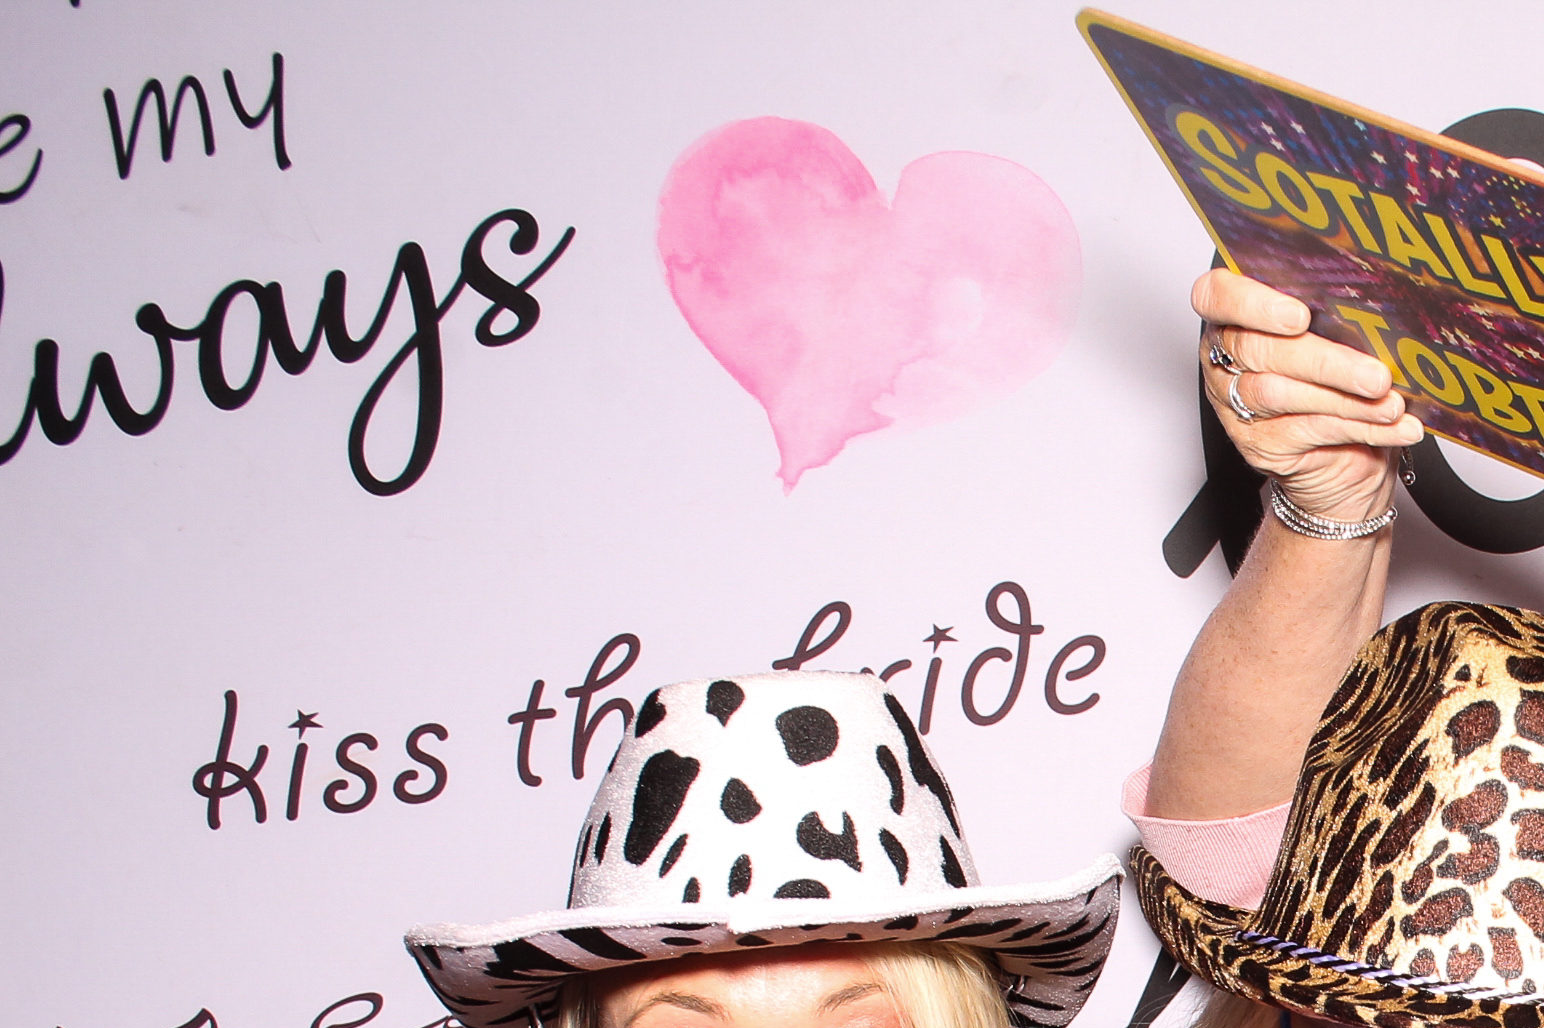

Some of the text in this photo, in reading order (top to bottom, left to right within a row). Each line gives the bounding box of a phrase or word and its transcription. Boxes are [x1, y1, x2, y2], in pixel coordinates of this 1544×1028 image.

[103, 52, 292, 180] my
[0, 208, 576, 498] ways
[192, 690, 449, 831] kiss
